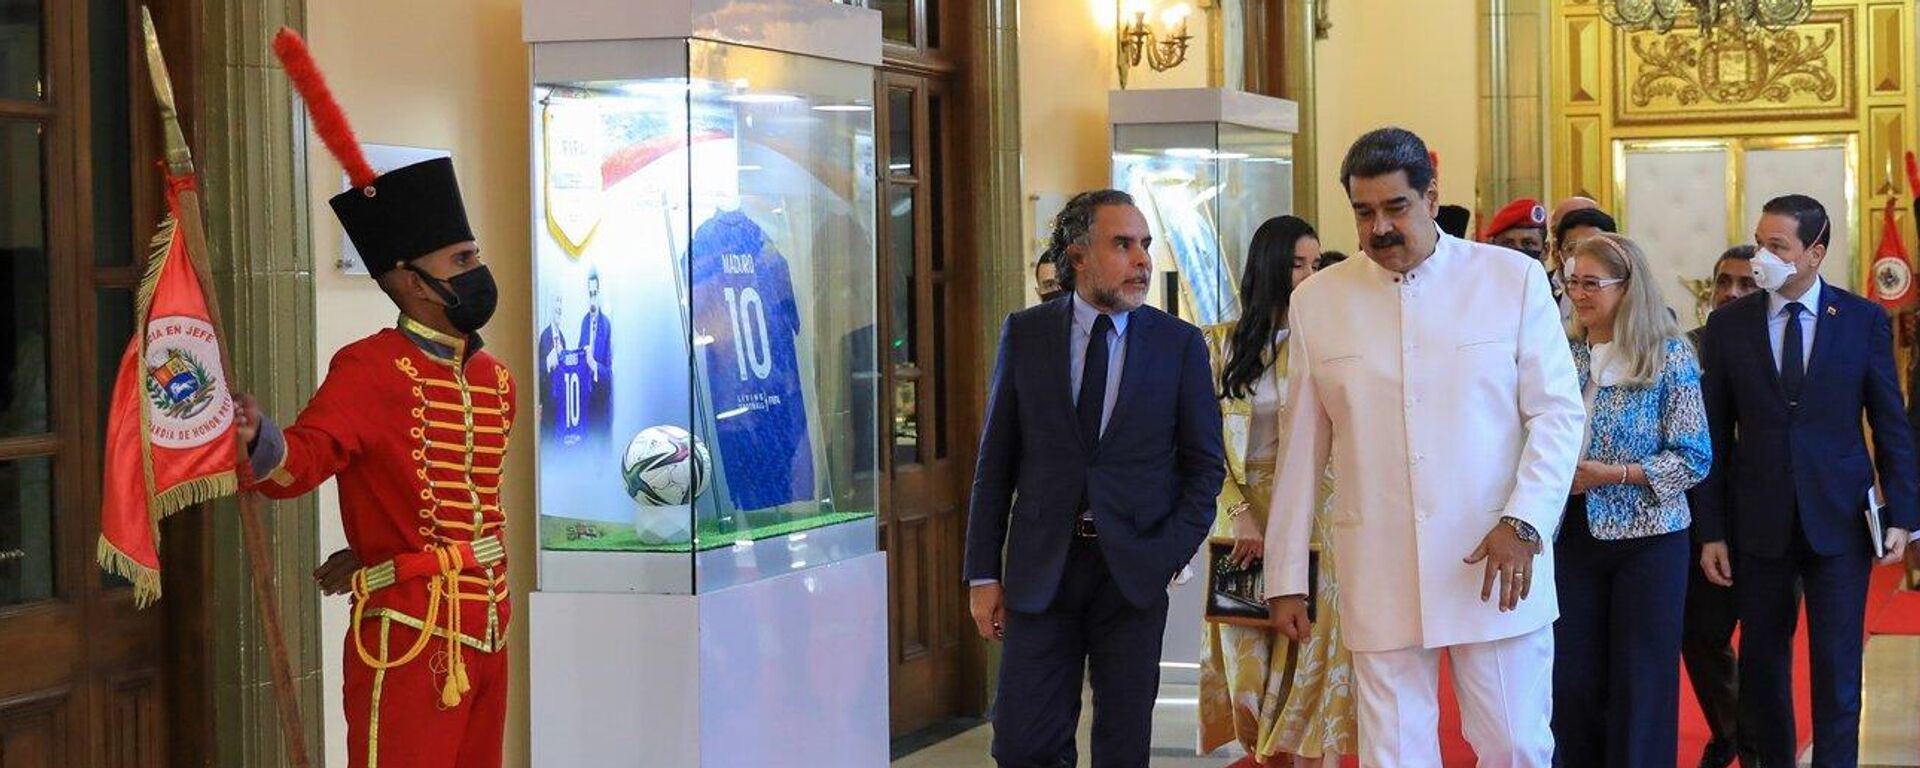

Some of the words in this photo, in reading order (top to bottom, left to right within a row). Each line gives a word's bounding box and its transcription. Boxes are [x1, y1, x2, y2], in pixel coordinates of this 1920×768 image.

[722, 254, 755, 274] MADURO
[166, 324, 181, 336] EN
[186, 326, 215, 344] JEFE
[724, 287, 772, 381] 10
[564, 372, 580, 428] 10
[179, 430, 190, 440] DE
